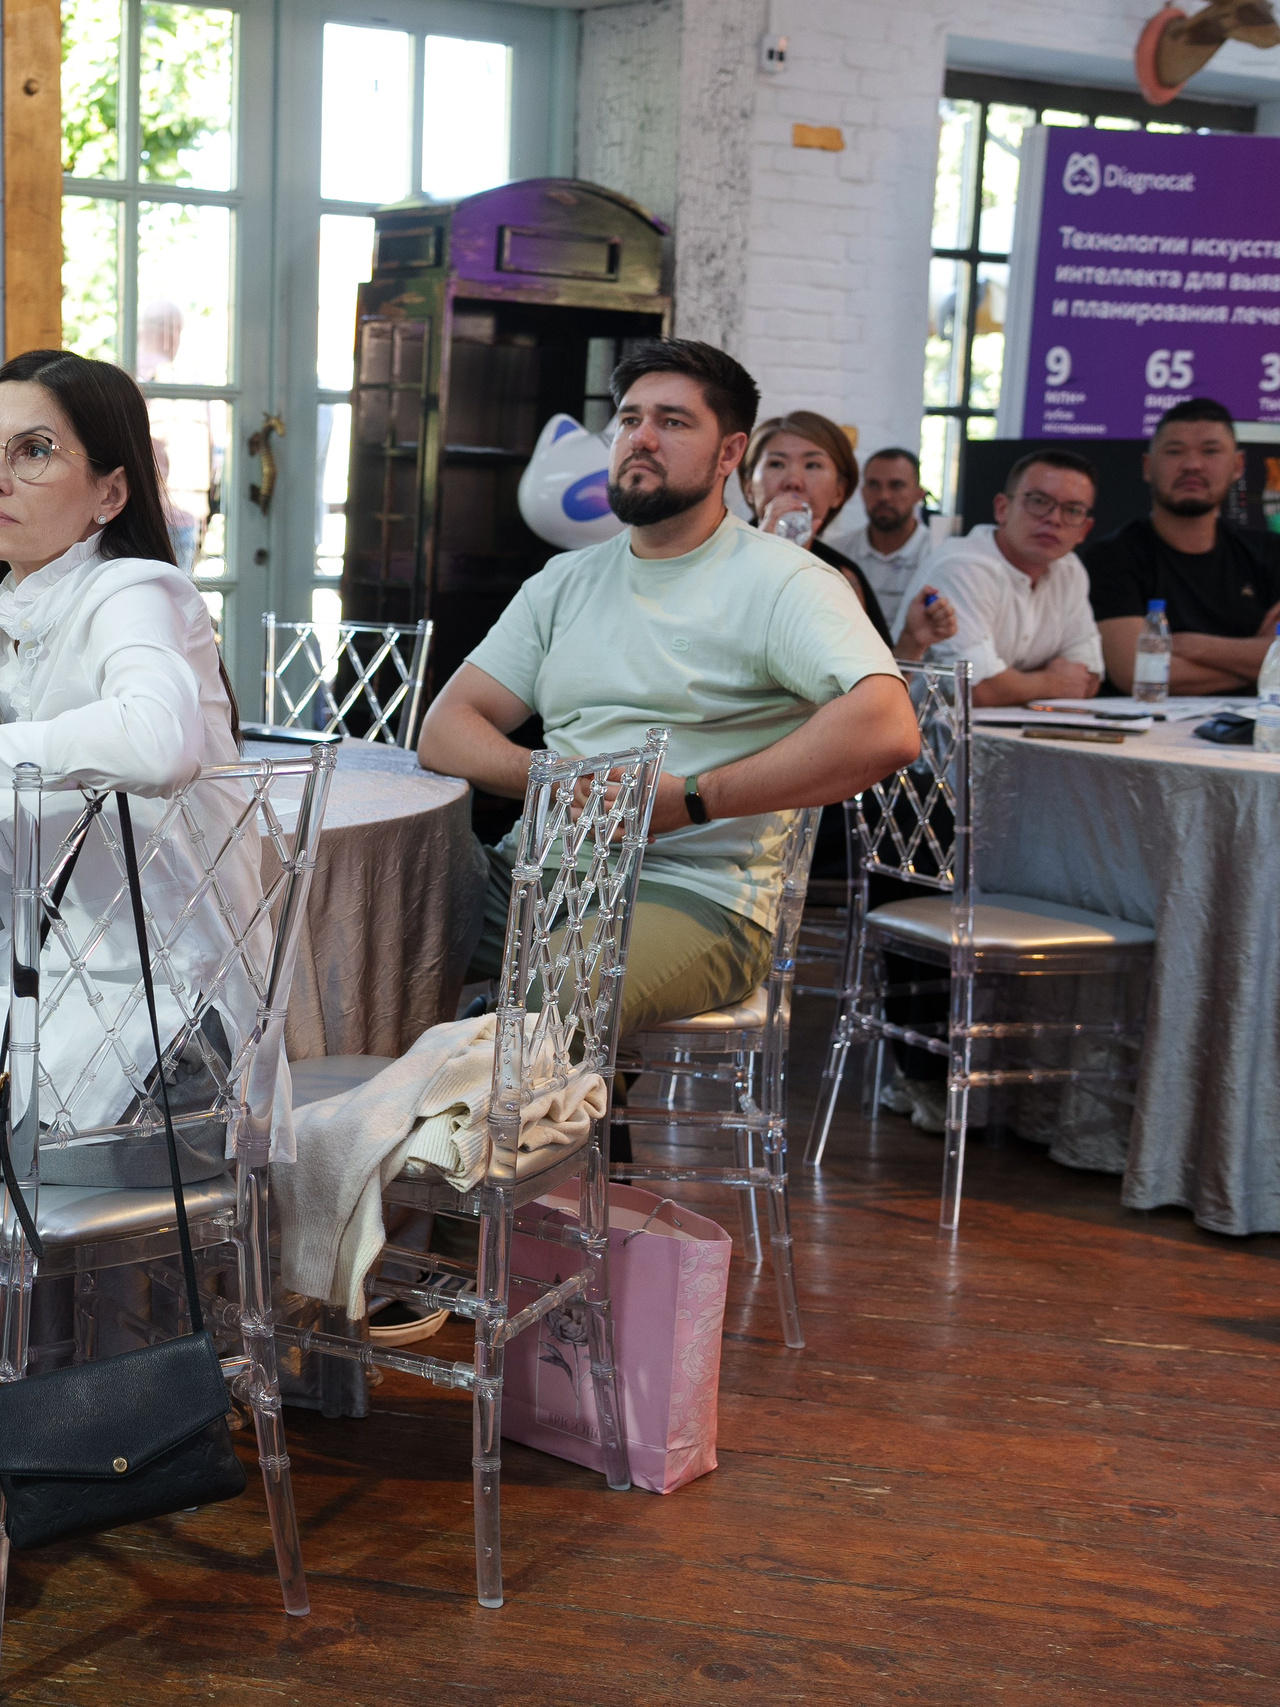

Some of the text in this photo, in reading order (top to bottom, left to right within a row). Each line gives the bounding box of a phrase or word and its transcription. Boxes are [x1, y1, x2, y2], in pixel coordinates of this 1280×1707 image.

[1103, 164, 1197, 195] Diagnocat
[1058, 225, 1189, 255] Технологии
[1055, 264, 1183, 289] интеллекта
[1183, 270, 1228, 292] для
[1051, 298, 1070, 317] и
[1070, 299, 1230, 327] планирования
[1045, 346, 1072, 387] 9
[1145, 348, 1195, 390] 65
